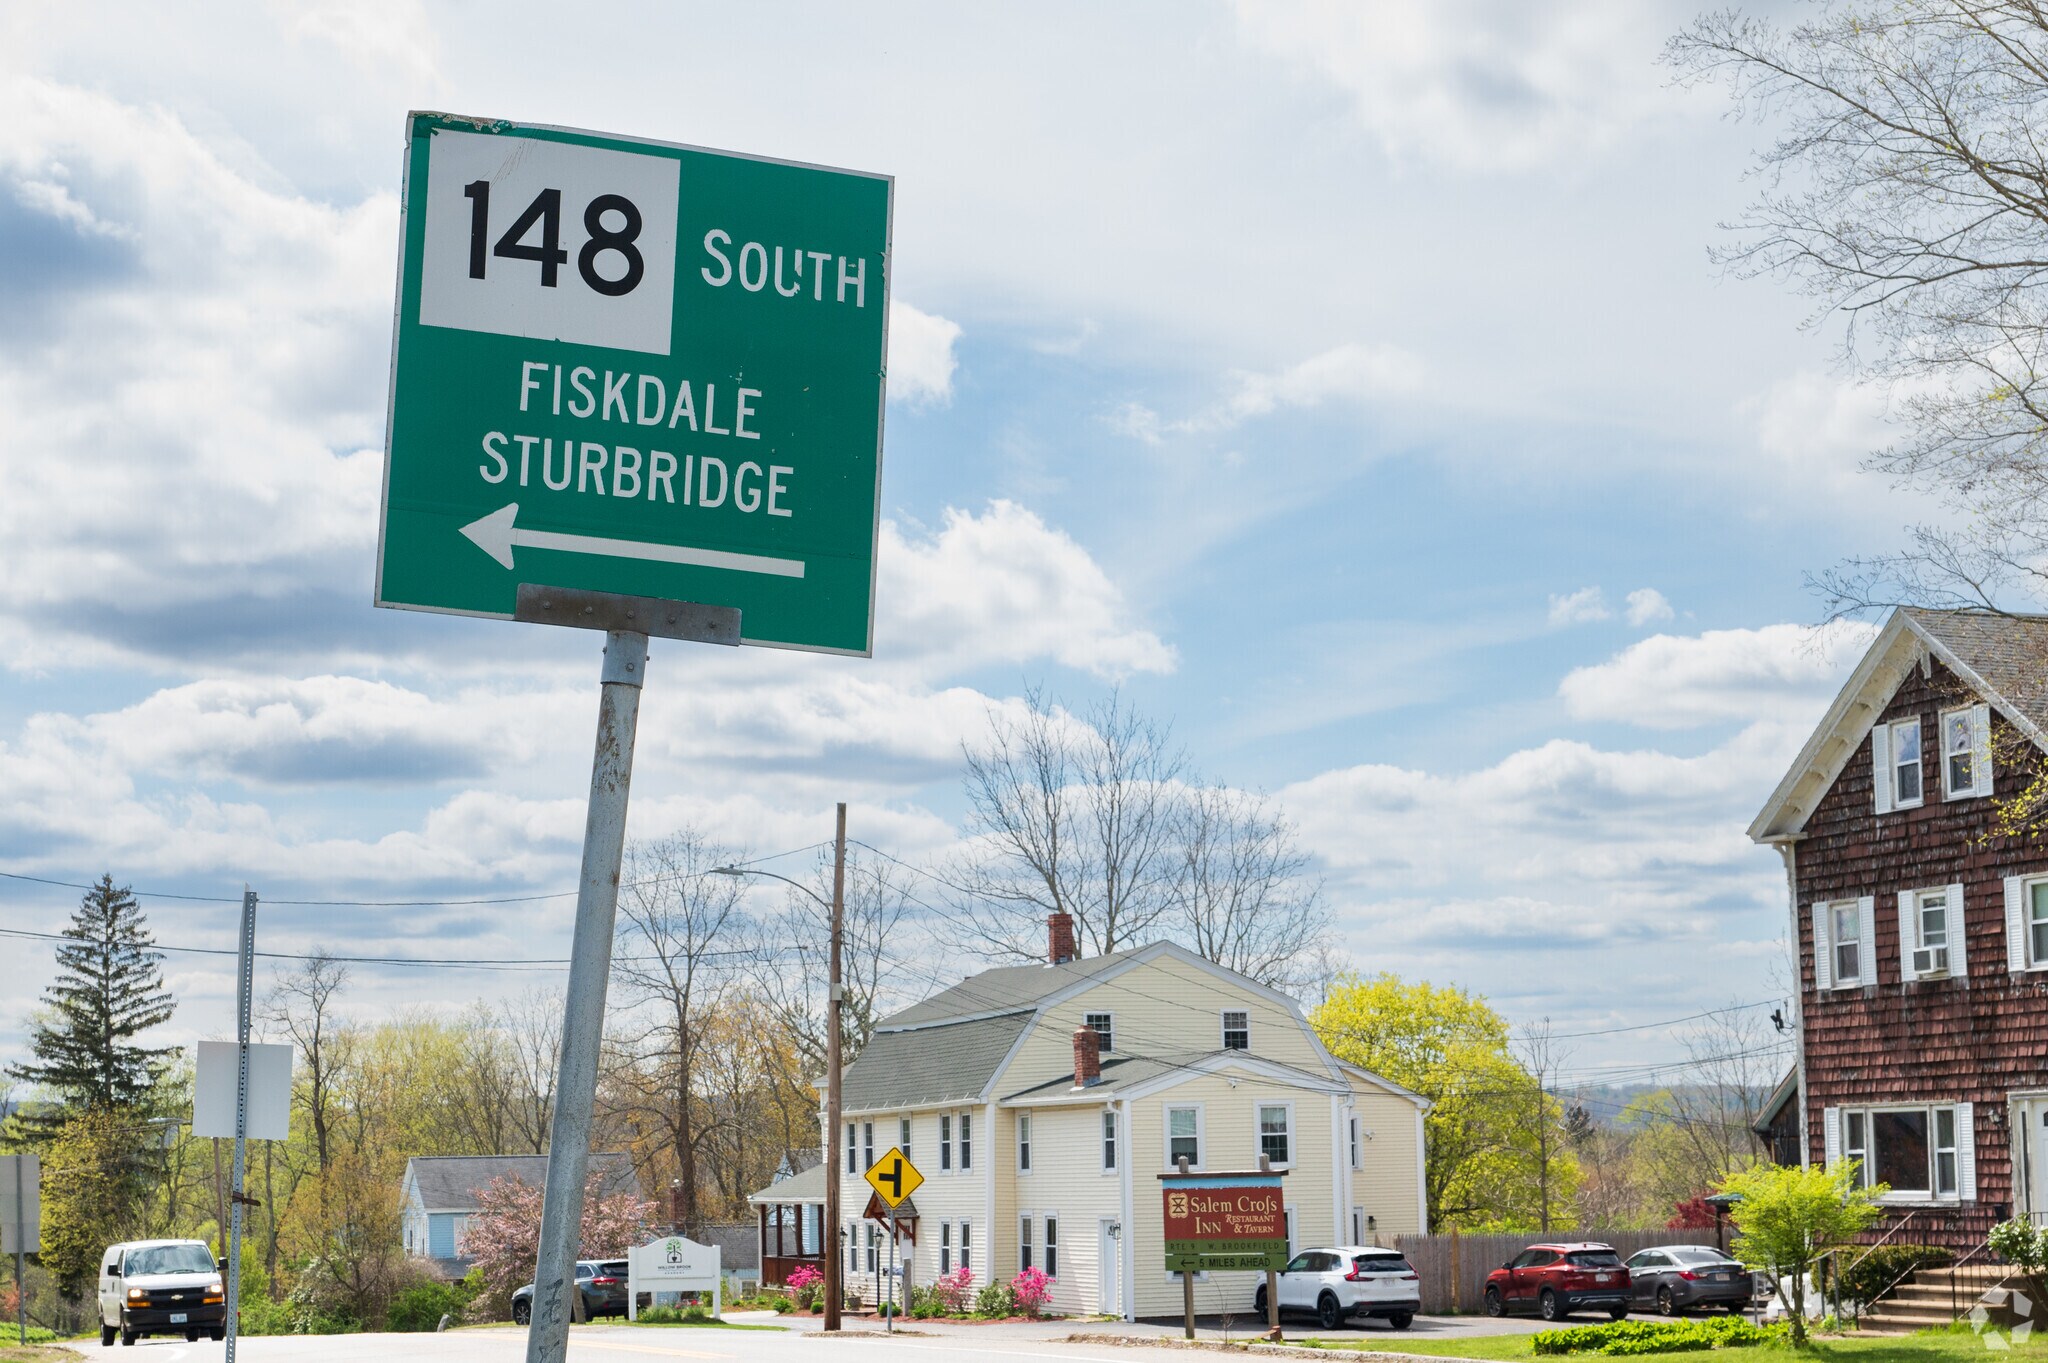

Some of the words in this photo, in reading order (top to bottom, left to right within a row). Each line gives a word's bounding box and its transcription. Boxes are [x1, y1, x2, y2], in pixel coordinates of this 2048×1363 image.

[465, 181, 644, 296] 148
[702, 229, 866, 307] SOUTH
[519, 361, 762, 439] FISKDALE
[479, 431, 794, 517] STURBRIDGE
[1190, 1196, 1232, 1213] Salem
[1195, 1216, 1221, 1234] INN
[1225, 1214, 1275, 1225] RESTAURANT
[1233, 1223, 1242, 1234] &
[1244, 1224, 1274, 1233] TAVERN
[1207, 1242, 1217, 1250] W.
[1222, 1242, 1280, 1250] BROOKFIELD
[1199, 1259, 1205, 1267] 5
[1208, 1258, 1236, 1267] MILES
[1240, 1257, 1271, 1267] AHEAD
